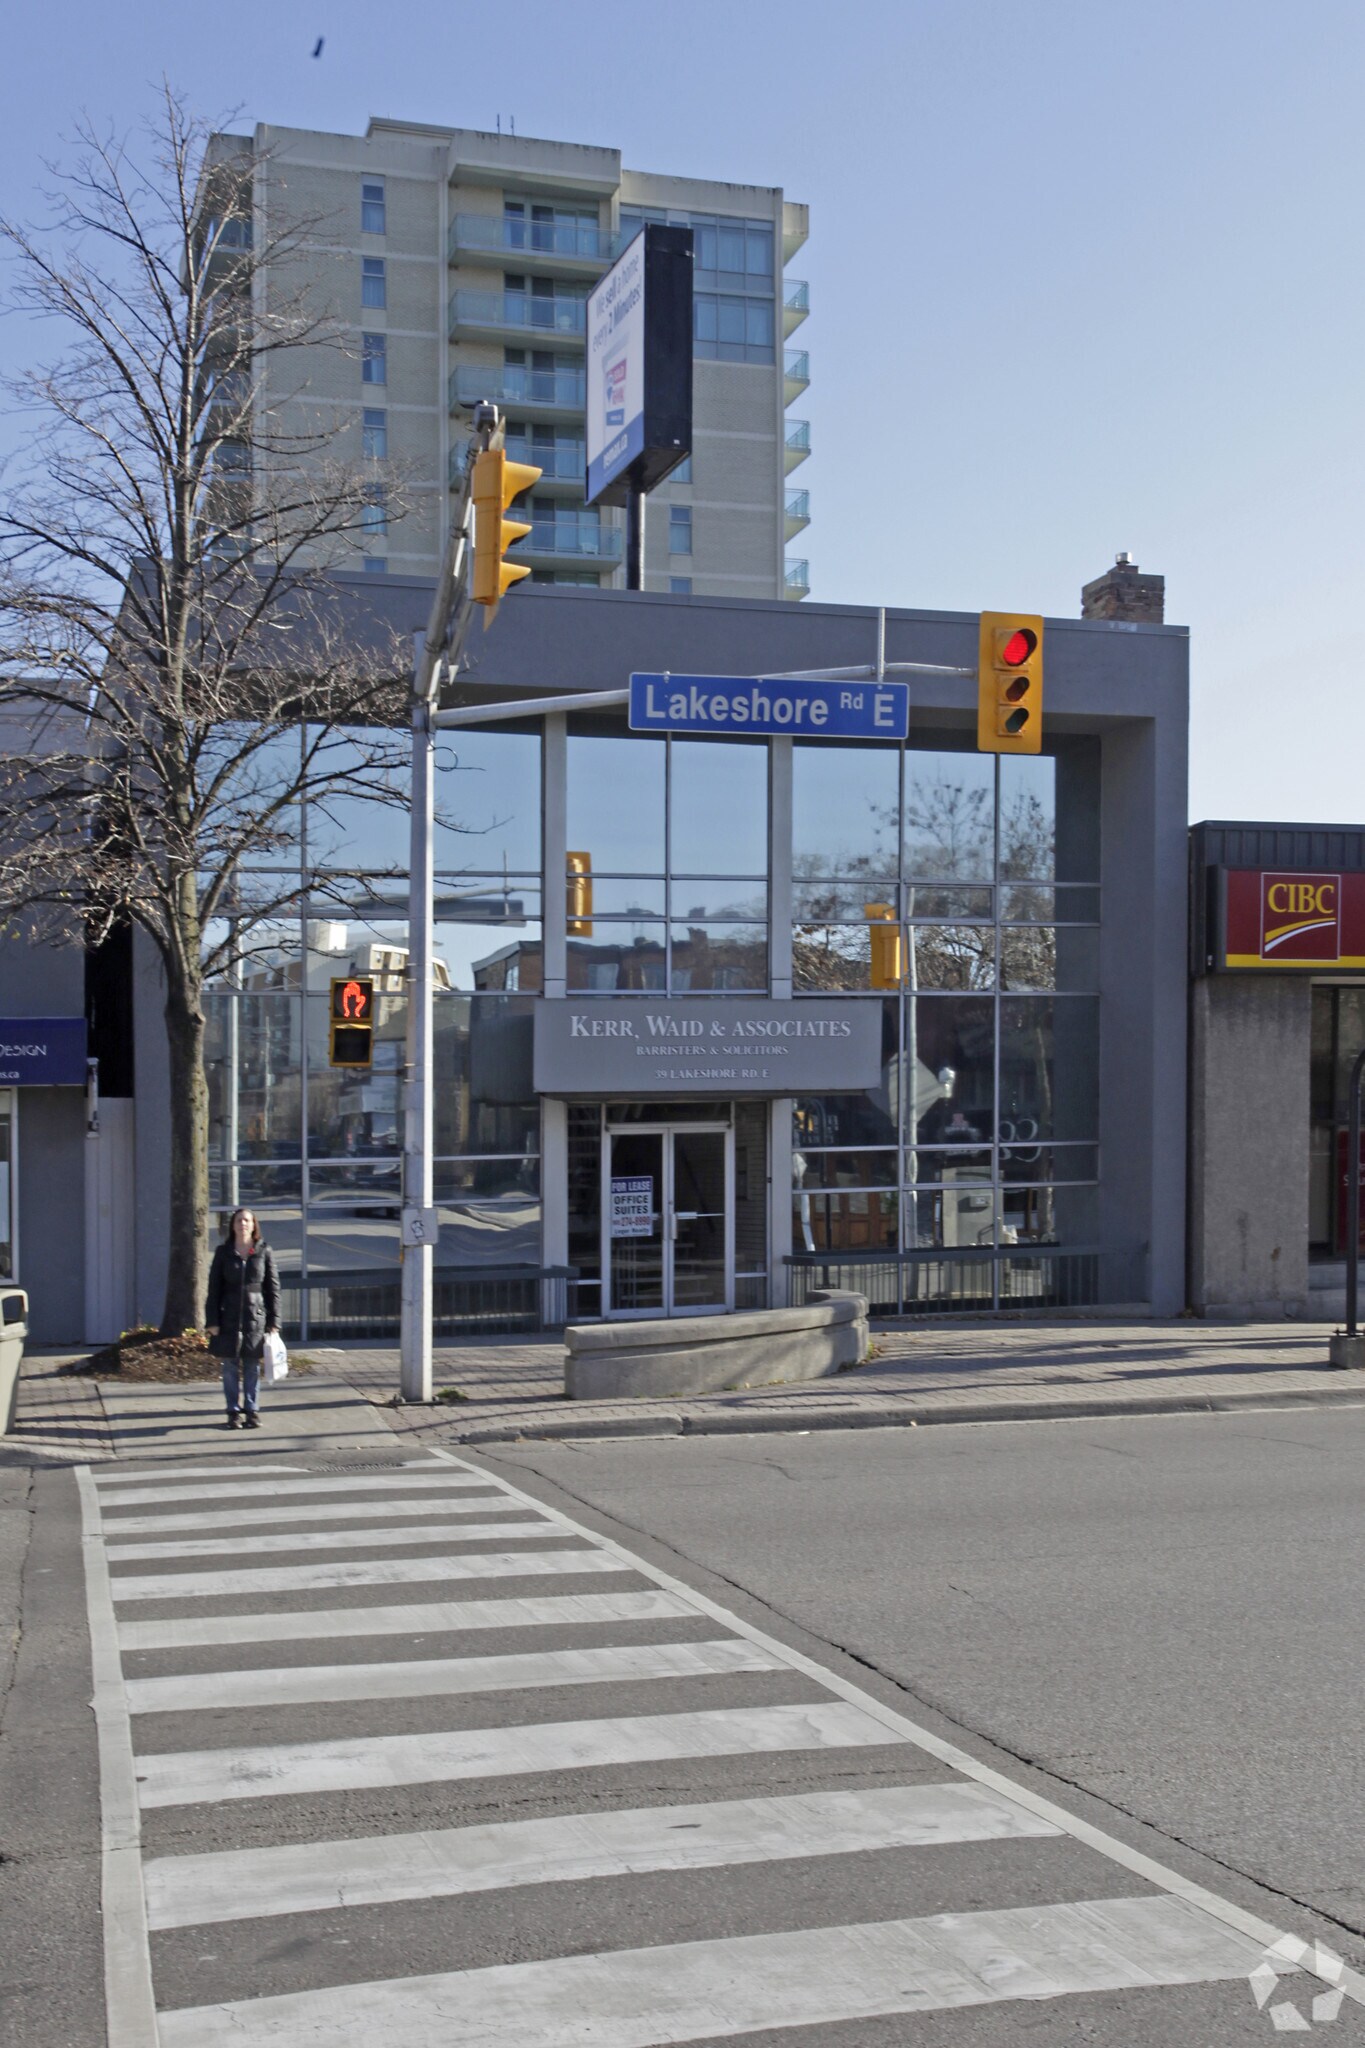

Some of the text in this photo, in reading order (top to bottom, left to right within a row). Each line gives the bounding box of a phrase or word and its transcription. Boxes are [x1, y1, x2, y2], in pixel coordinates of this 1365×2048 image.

[606, 275, 617, 308] sell
[608, 311, 613, 334] 2
[646, 684, 895, 727] Lakeshore Rd E
[1267, 883, 1335, 914] CIBC
[645, 1015, 704, 1037] WAID
[709, 1020, 726, 1037] &
[732, 1020, 852, 1037] ASSOCIATES
[636, 1046, 789, 1056] BARRISTERS & SOLICITORS
[655, 1069, 667, 1079] 39
[670, 1069, 738, 1079] LAKESHORE
[762, 1069, 770, 1078] E
[612, 1181, 651, 1192] FOR LEASE
[614, 1195, 649, 1205] OFFICE
[614, 1205, 649, 1215] SUITES
